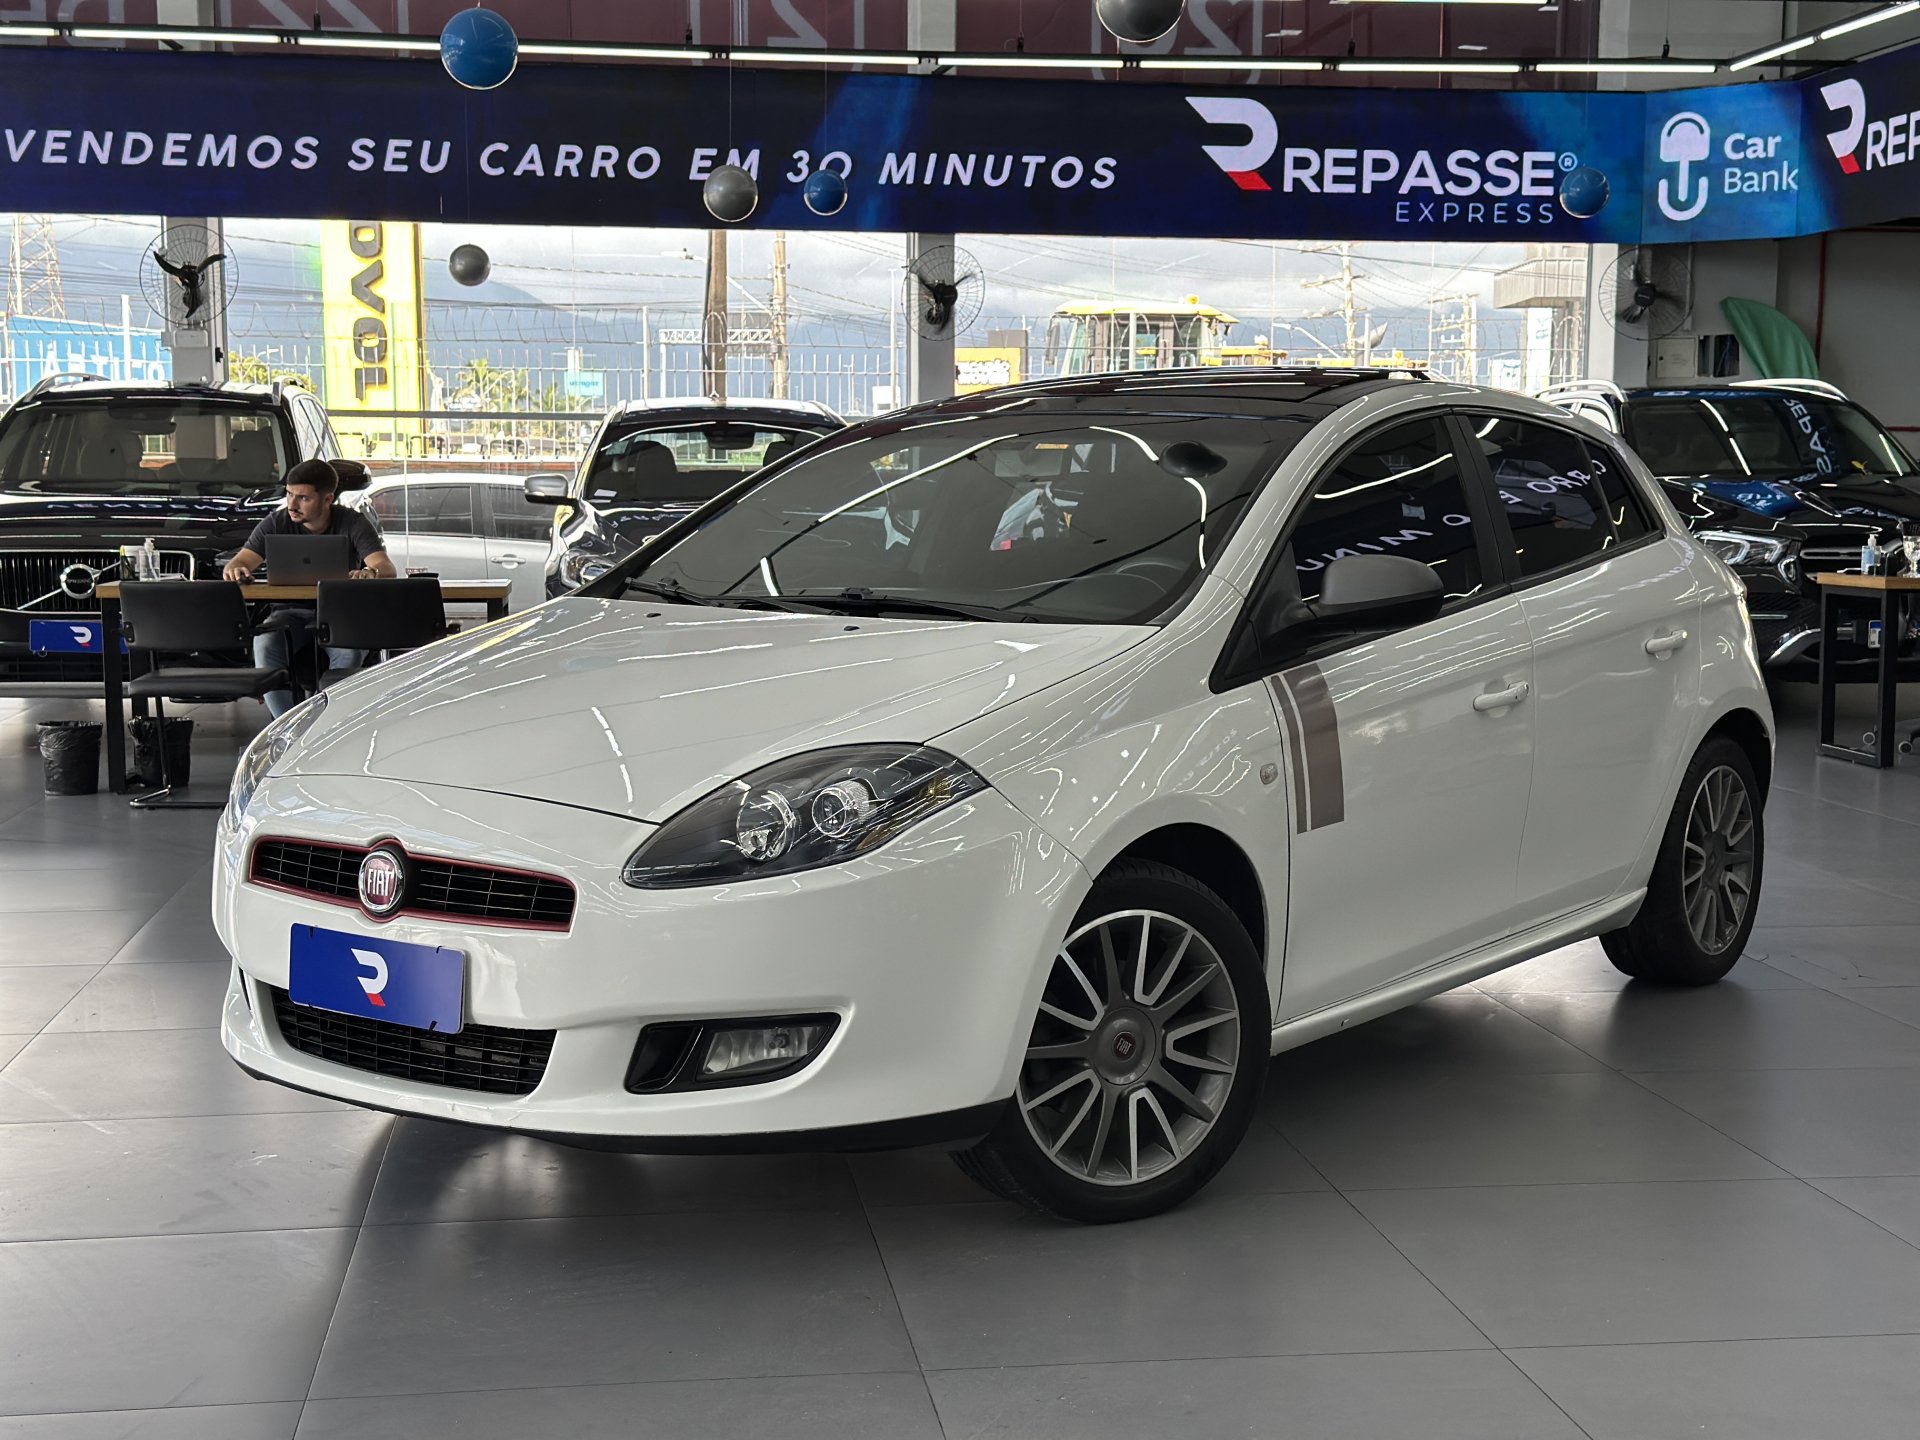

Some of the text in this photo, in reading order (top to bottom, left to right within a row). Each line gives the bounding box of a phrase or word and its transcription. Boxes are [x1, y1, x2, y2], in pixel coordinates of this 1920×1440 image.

[4, 129, 320, 171] VENDEMOS
[347, 137, 452, 175] SEU
[479, 143, 662, 180] CARRO
[689, 148, 761, 181] EM
[878, 152, 1118, 189] MINUTOS
[1723, 132, 1782, 160] Car
[1723, 160, 1799, 194] Bank
[1395, 201, 1554, 224] EXPRESS
[367, 867, 396, 897] FIAT
